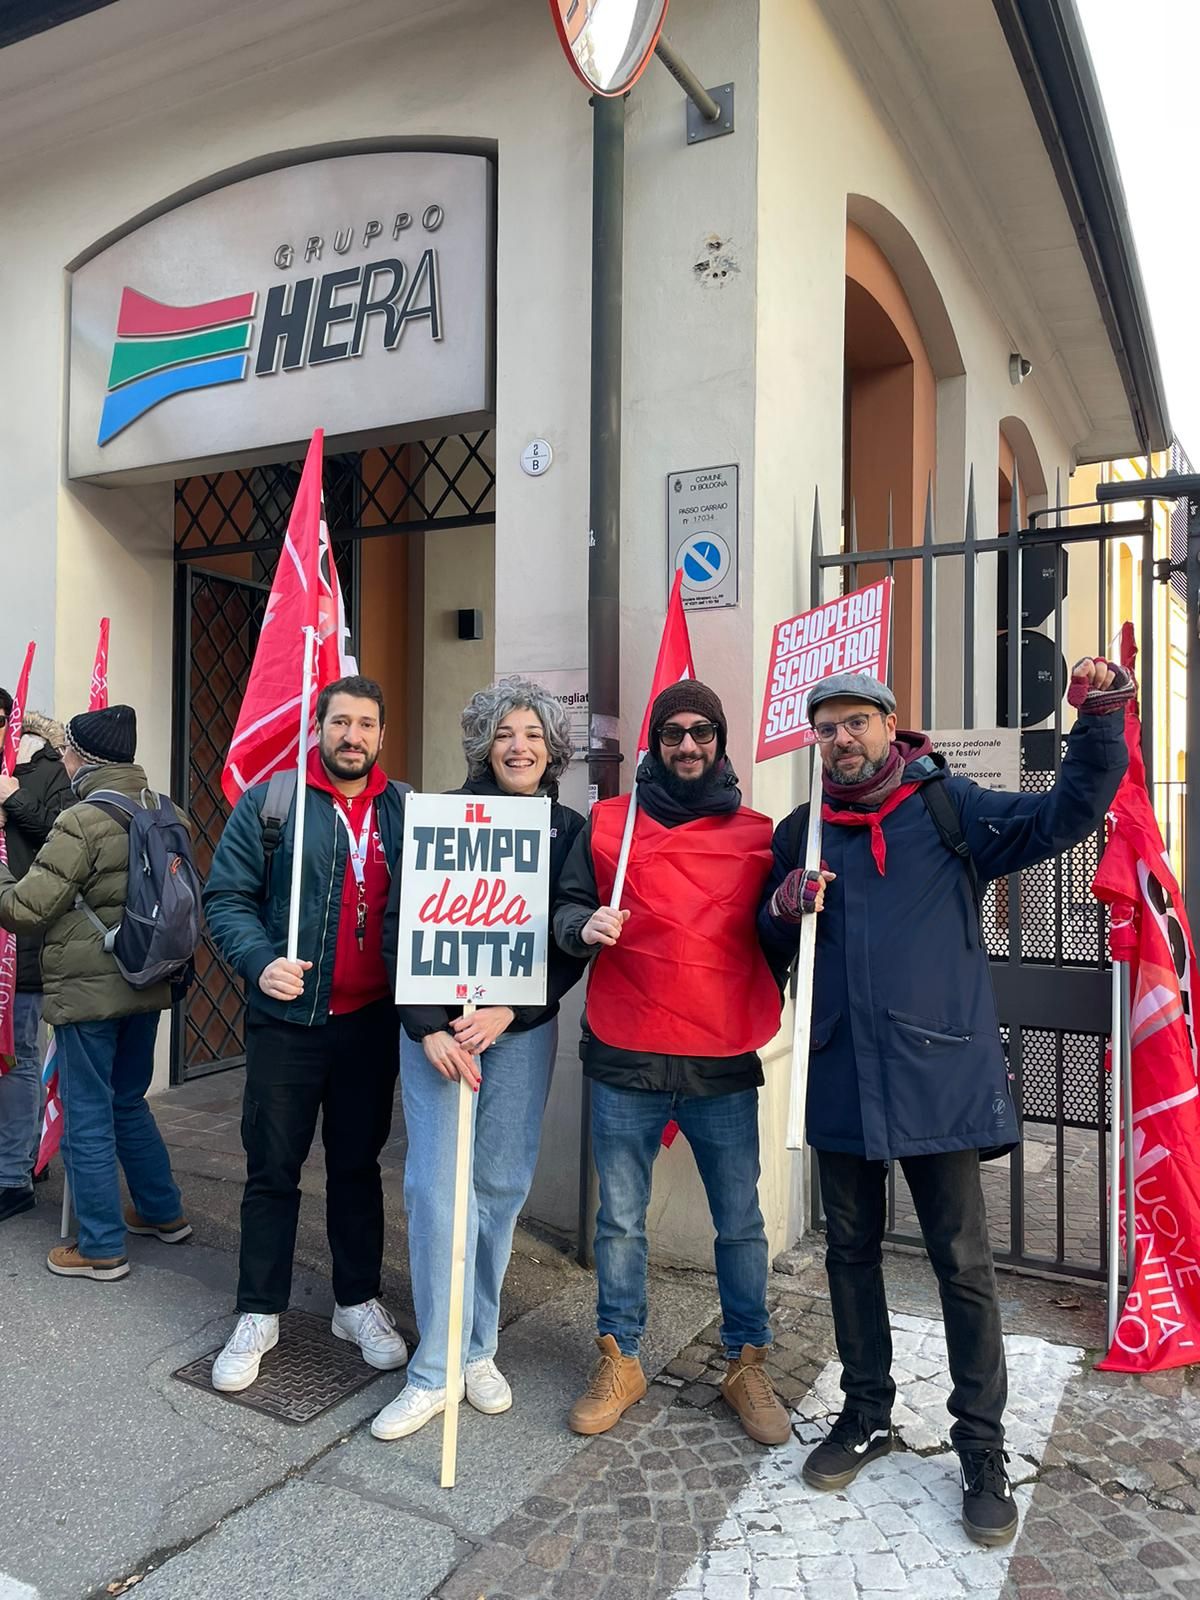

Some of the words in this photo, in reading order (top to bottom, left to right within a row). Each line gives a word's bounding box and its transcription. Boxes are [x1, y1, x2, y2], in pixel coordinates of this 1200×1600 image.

[274, 204, 443, 269] GRUPPO
[255, 248, 442, 376] HERA
[532, 460, 540, 471] B
[695, 474, 722, 483] COMUNE
[697, 480, 728, 491] BOLOGNA
[679, 506, 699, 514] PASSO
[701, 502, 728, 513] CARRAIO
[776, 584, 884, 656] SCIOPERO!
[771, 622, 881, 696] SCIOPERO!
[963, 740, 1001, 748] pedonale
[413, 826, 541, 873] TEMPO
[418, 877, 532, 926] della
[411, 930, 535, 977] LOTTA
